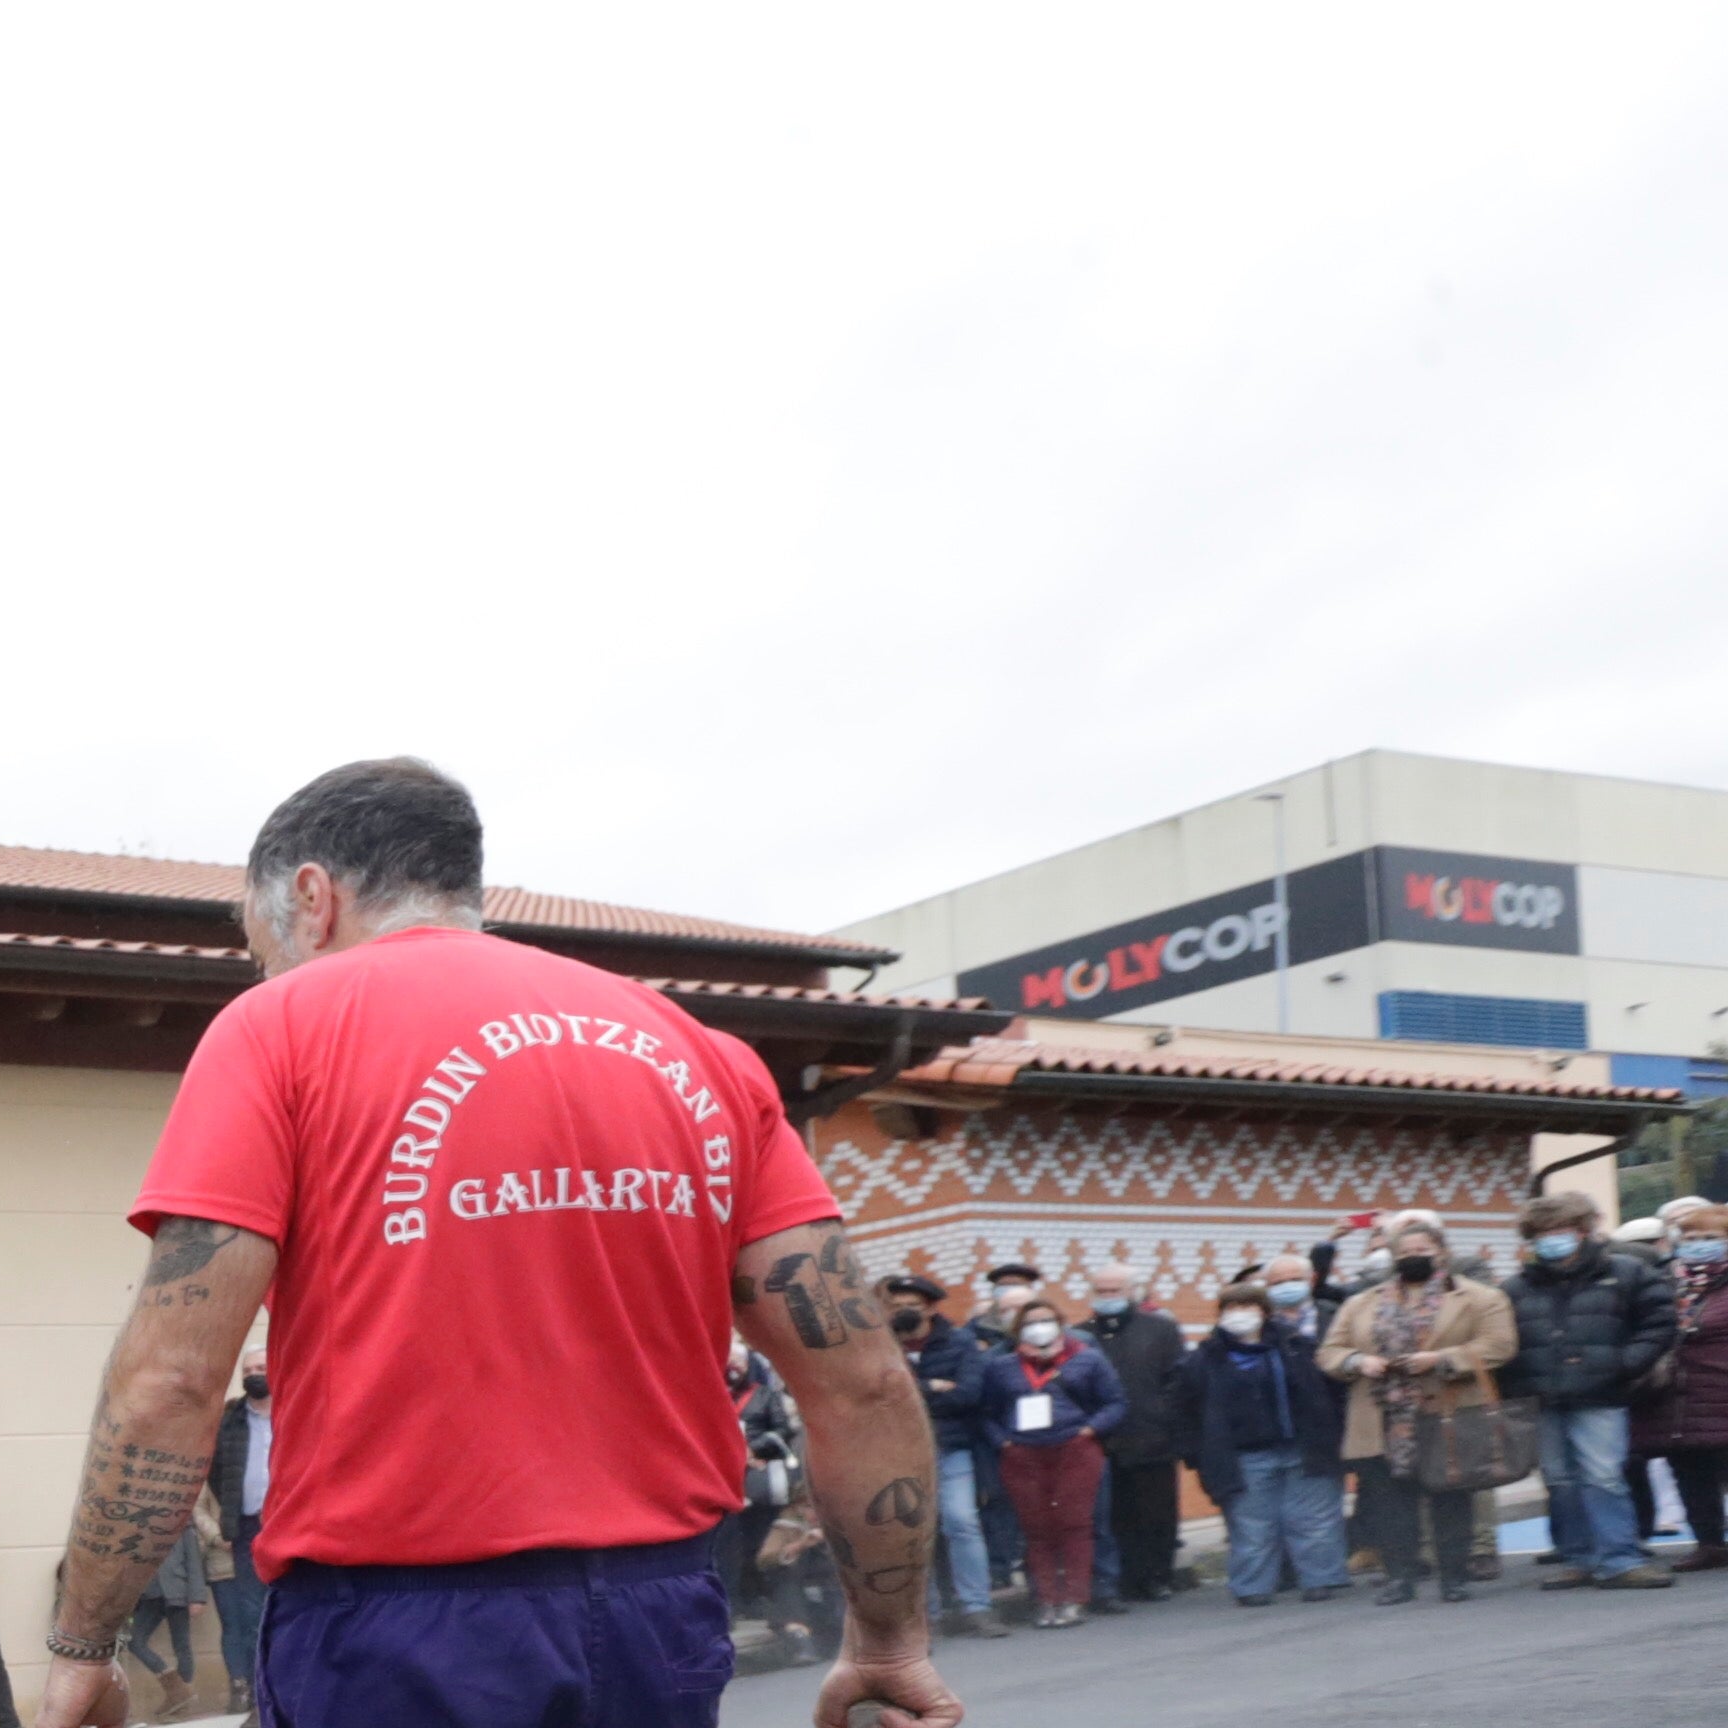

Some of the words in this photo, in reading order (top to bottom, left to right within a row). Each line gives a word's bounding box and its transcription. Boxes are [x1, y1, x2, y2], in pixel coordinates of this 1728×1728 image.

[1404, 872, 1564, 930] MOLYCOP
[1021, 902, 1290, 1009] MOLYCOP
[383, 1046, 487, 1246] BURDIN
[479, 1012, 720, 1124] BIOTZEAN
[450, 1167, 696, 1220] GALLARTA
